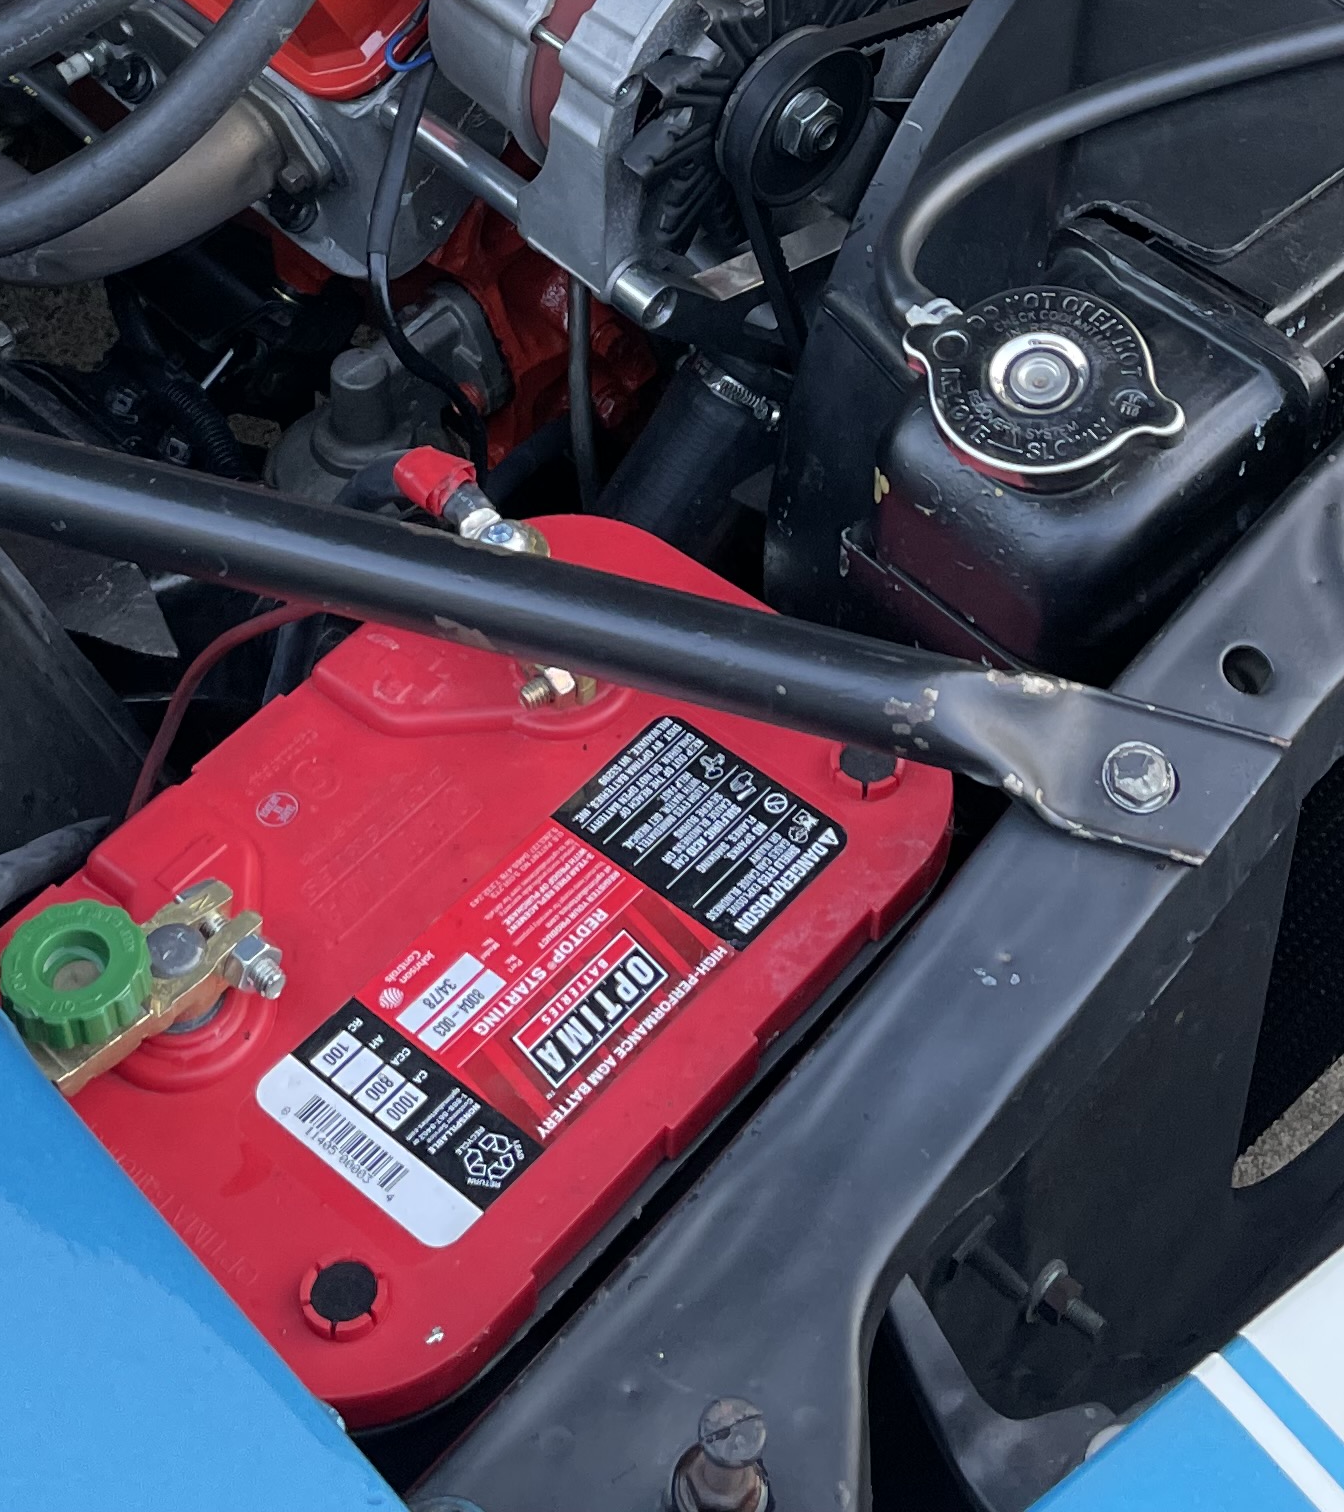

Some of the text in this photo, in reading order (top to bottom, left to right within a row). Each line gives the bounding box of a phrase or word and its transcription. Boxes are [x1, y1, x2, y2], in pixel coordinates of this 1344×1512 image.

[1026, 421, 1079, 439] SYSTEM
[649, 739, 665, 752] BY
[659, 723, 682, 742] DIST.
[596, 754, 632, 786] WI 53209
[616, 737, 704, 818] KEEP OUT OF THE REACH OF
[624, 748, 654, 775] OPTIMA
[647, 762, 663, 775] DO
[672, 770, 693, 788] HELP
[616, 784, 639, 804] OPEN
[634, 772, 652, 787] NOT
[570, 807, 591, 825] INC.
[632, 781, 709, 854] FLUSH EYES IMMEDIATELY
[646, 776, 701, 826] WITH GET
[671, 790, 723, 839] SEVERE BURNS
[660, 796, 732, 864] CAUSE BLINDNESS OR
[670, 802, 741, 870] SULFURIC ACID CAN
[750, 820, 767, 836] NO
[694, 839, 730, 874] SMOKING
[746, 831, 781, 864] OR INJURY
[537, 881, 550, 893] OF
[704, 837, 790, 923] GASES CAN CAUSE BLINDNESS
[725, 842, 801, 918] SHIELD EYES EXPLOSIVE
[733, 841, 828, 934] DANGER/POISON
[504, 888, 556, 935] REPLACEMENT
[535, 869, 621, 949] REGISTER YOUR PRODUCT
[382, 948, 422, 983] Controls
[396, 950, 436, 985] Johnson
[506, 958, 523, 973] Part
[420, 977, 458, 1010] 34/78
[471, 965, 548, 1037] STARTING
[538, 957, 610, 1025] BATTERIES
[531, 953, 660, 1073] OPTIMA
[315, 1016, 366, 1065] RC 100
[364, 1033, 387, 1049] AH
[532, 944, 728, 1138] HIGH-PERFORMANCE AGM BATTERY
[357, 1046, 414, 1101] CCA 800
[380, 1068, 430, 1122] CA 1000
[424, 1101, 483, 1154] NONSPILLABLE
[455, 1126, 485, 1155] RECYCLE
[466, 1176, 502, 1189] RETURN
